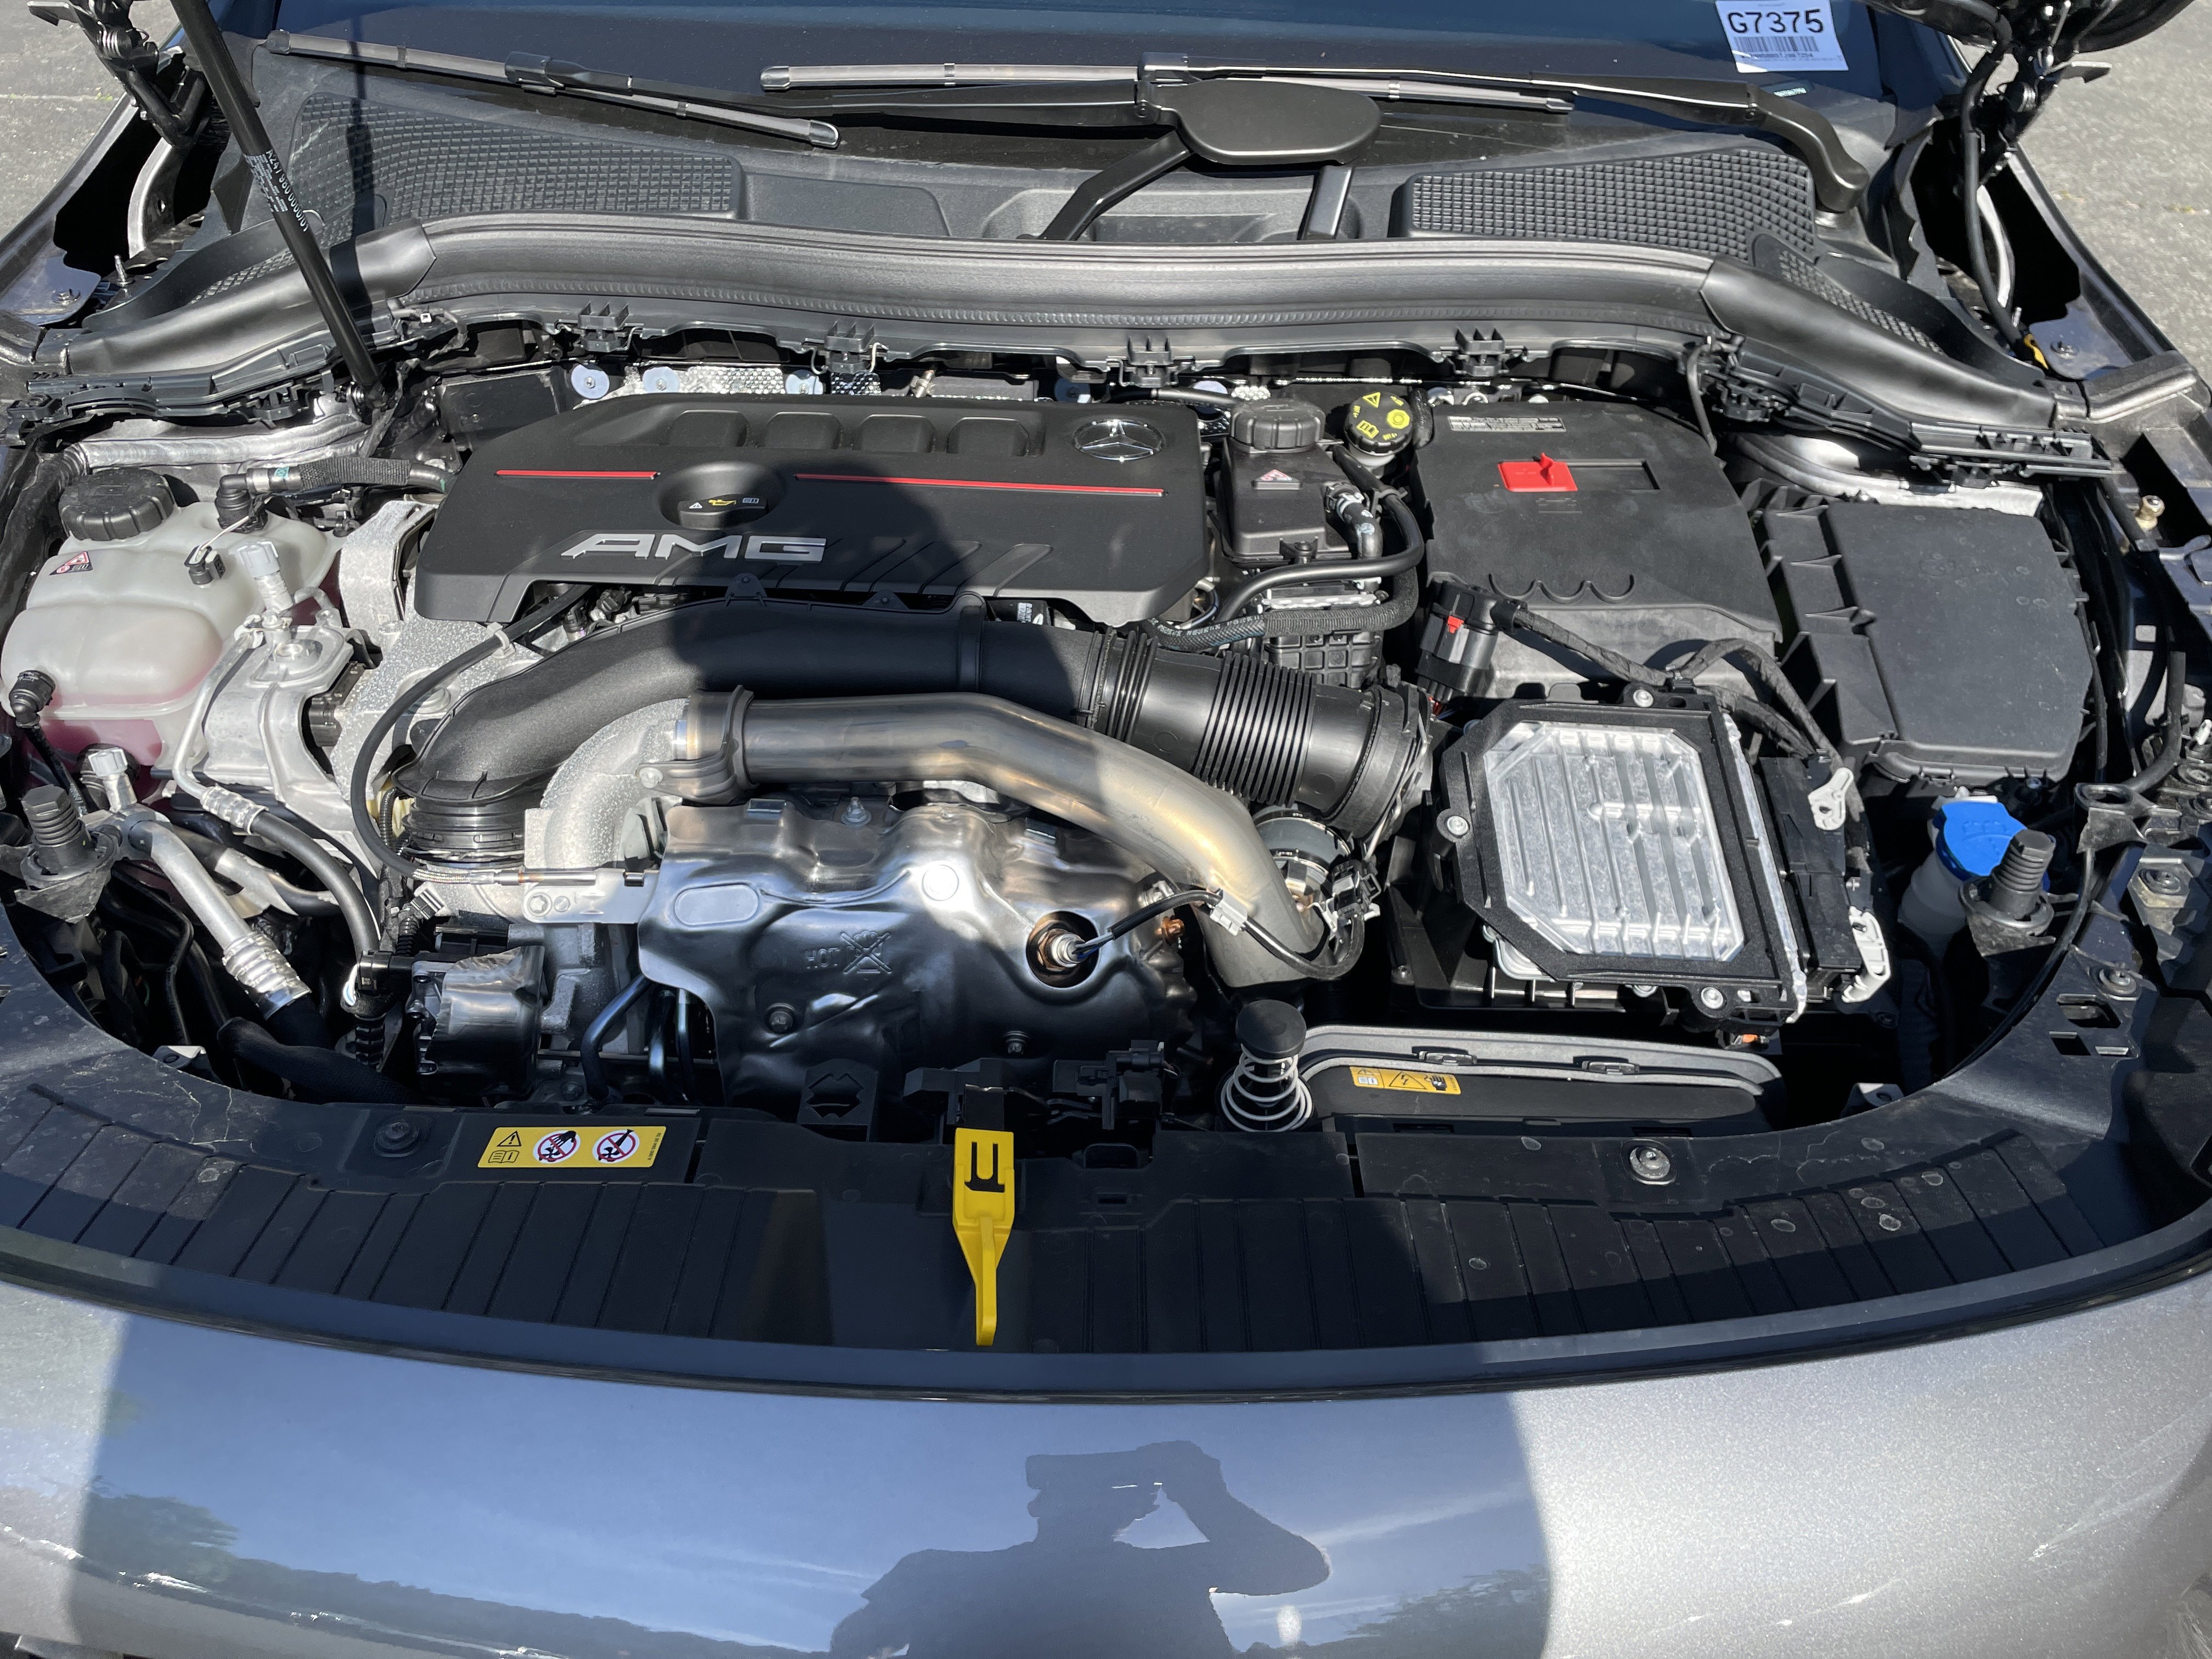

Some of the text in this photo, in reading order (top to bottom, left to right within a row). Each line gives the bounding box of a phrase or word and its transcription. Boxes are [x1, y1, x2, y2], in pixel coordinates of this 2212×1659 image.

[1728, 9, 1823, 33] G7375
[561, 533, 827, 562] AMG
[805, 947, 840, 969] HOT
